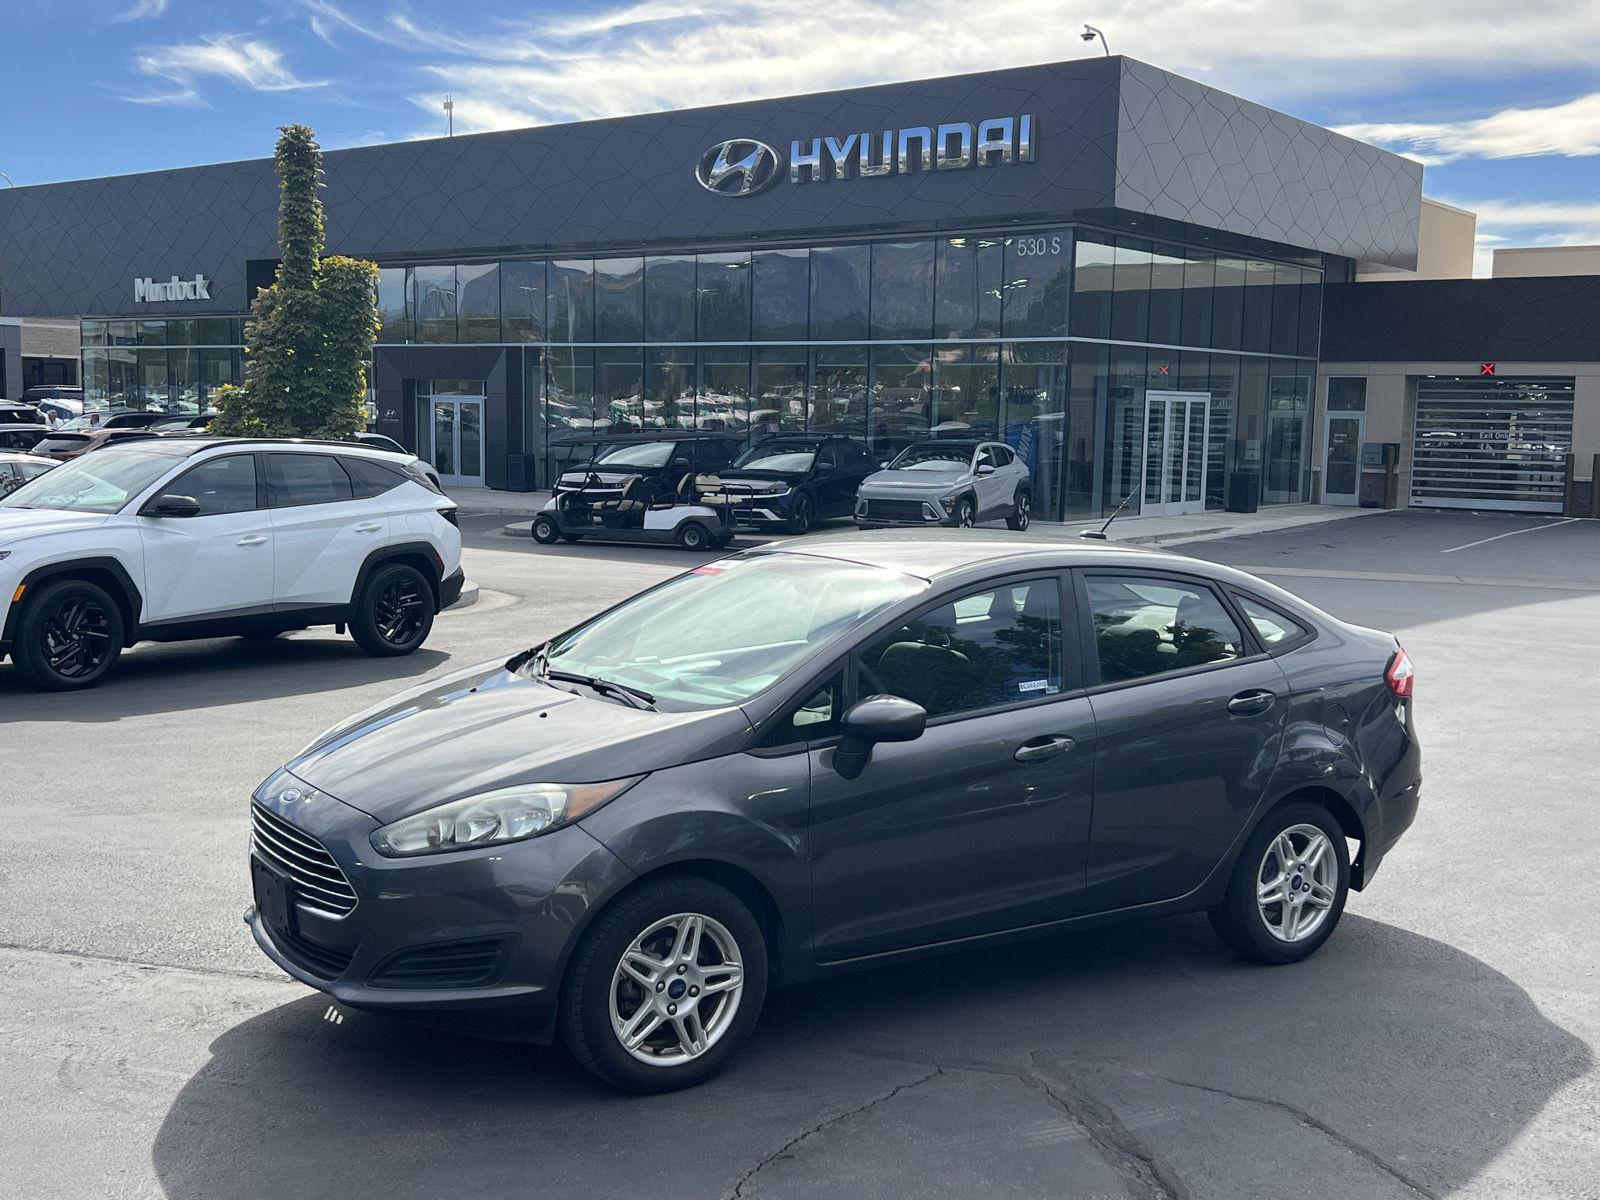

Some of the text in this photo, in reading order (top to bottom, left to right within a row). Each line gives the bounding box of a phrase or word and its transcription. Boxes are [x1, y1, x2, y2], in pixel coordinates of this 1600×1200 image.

[790, 114, 1034, 185] HYUNDAI
[1017, 236, 1061, 256] 530 S
[134, 274, 211, 303] Murdock
[1480, 431, 1493, 439] Exit
